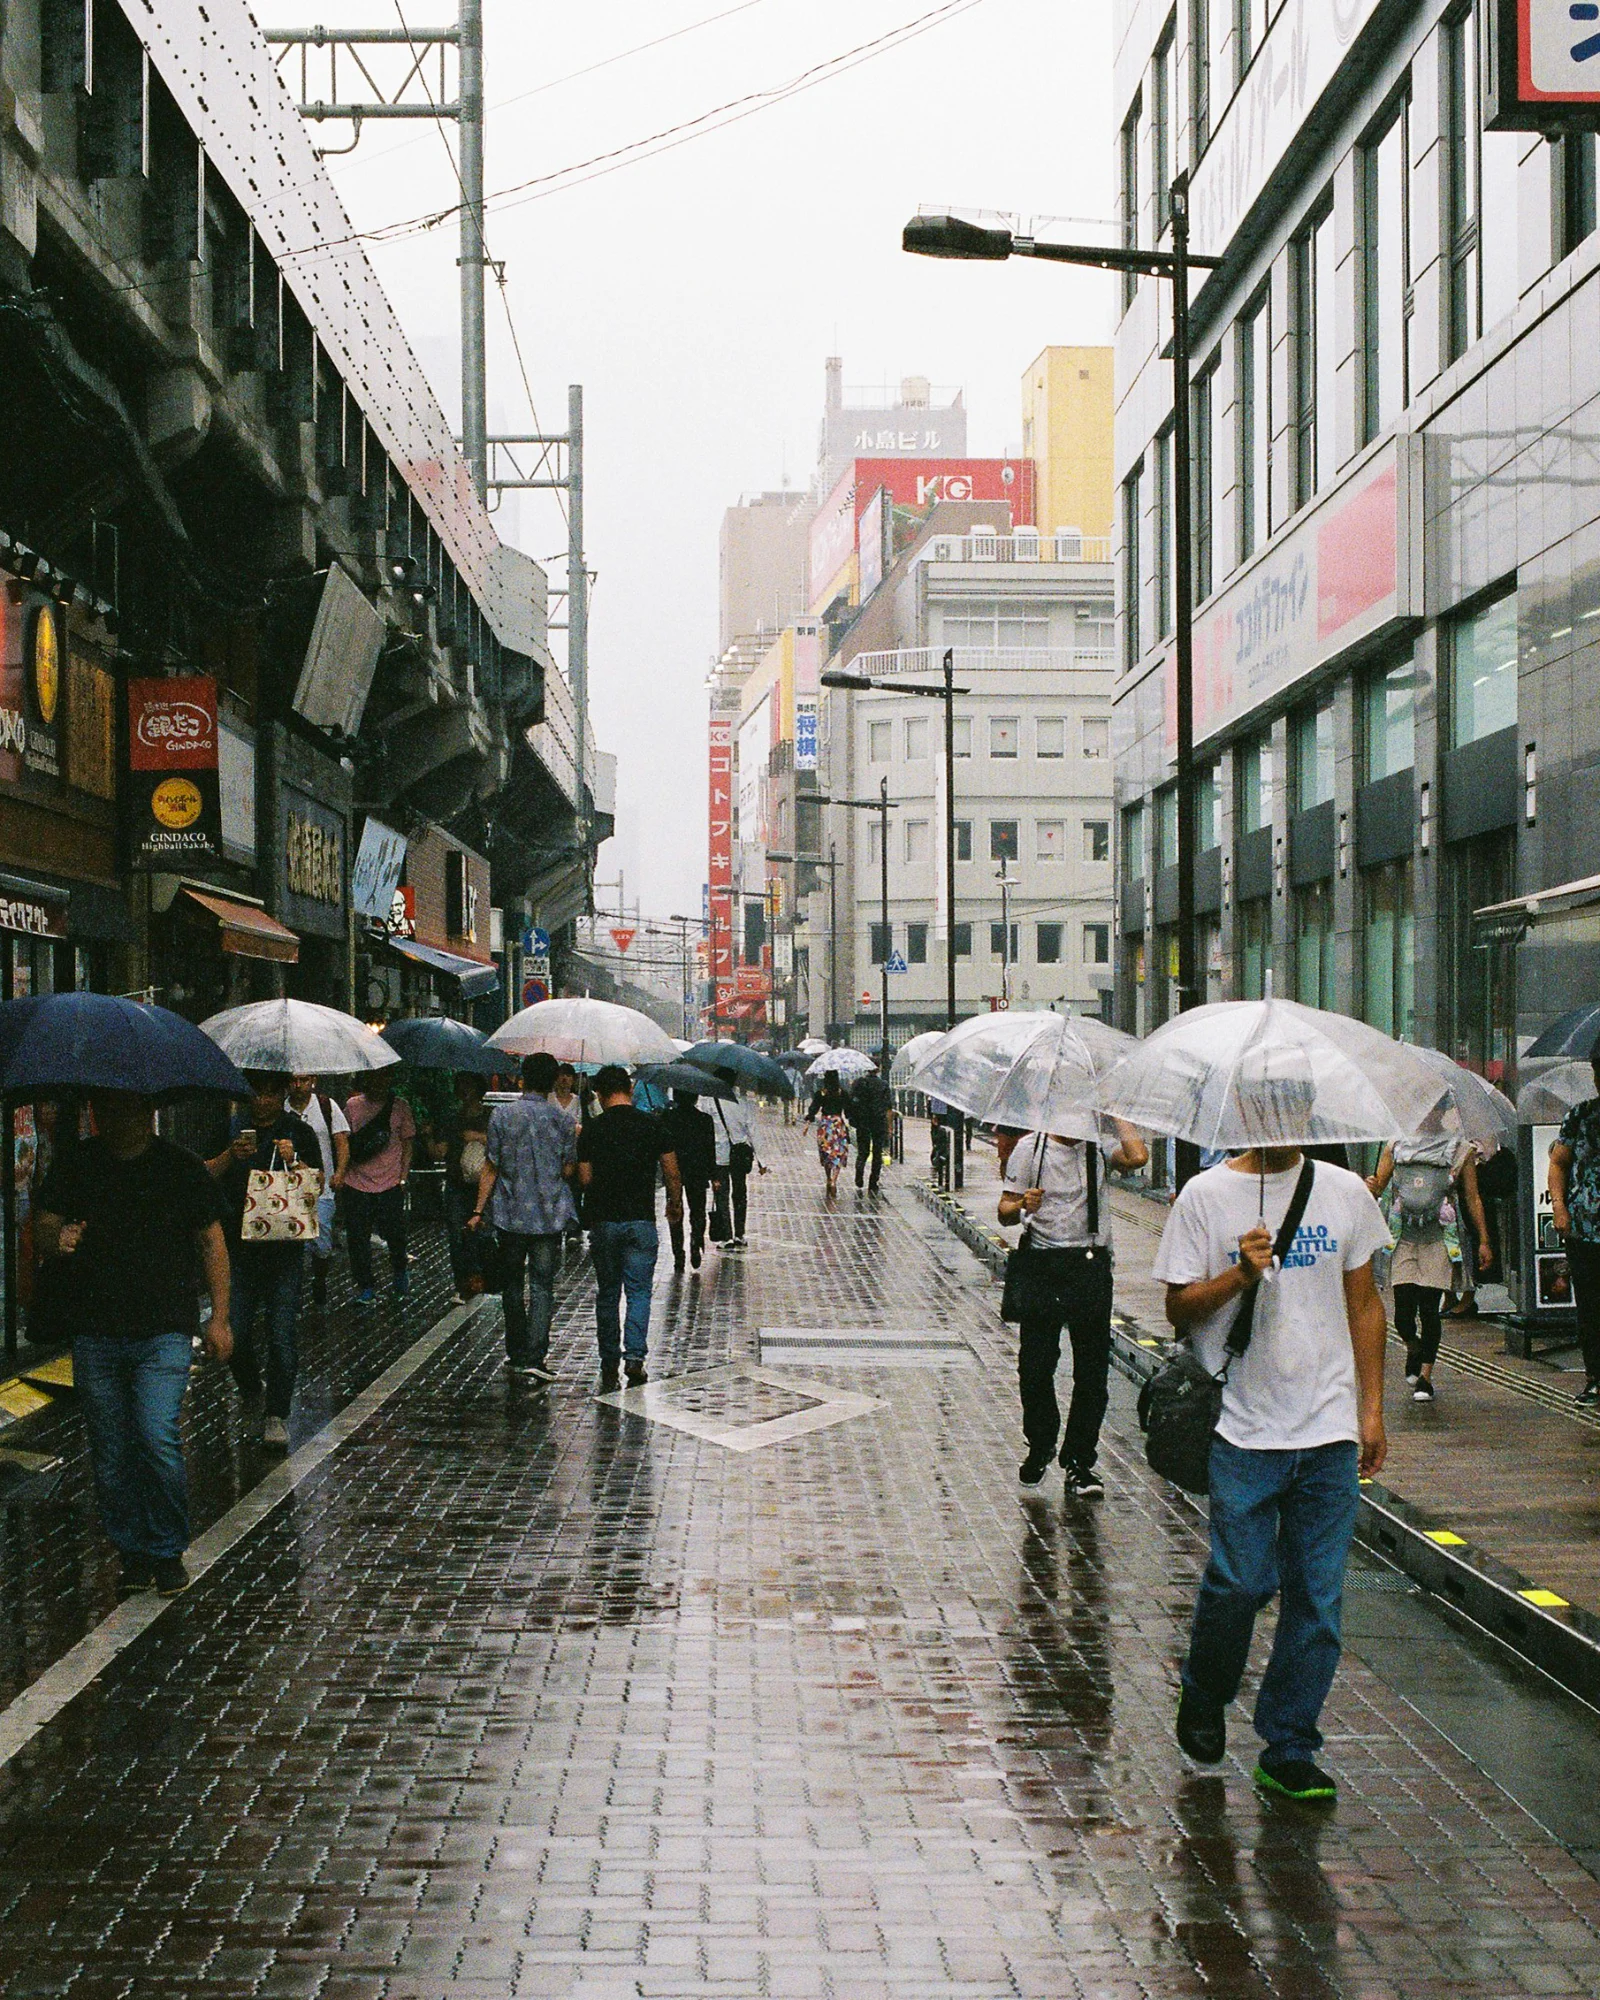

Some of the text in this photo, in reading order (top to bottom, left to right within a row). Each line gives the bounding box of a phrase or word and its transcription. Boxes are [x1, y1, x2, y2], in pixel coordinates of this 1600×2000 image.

[854, 430, 941, 450] 小島ビル
[916, 475, 973, 505] KG
[146, 710, 200, 738] 銀だこ
[166, 740, 212, 750] GINDACO
[797, 715, 817, 757] 将棋
[141, 841, 183, 851] Highball
[150, 833, 206, 842] GINDACO
